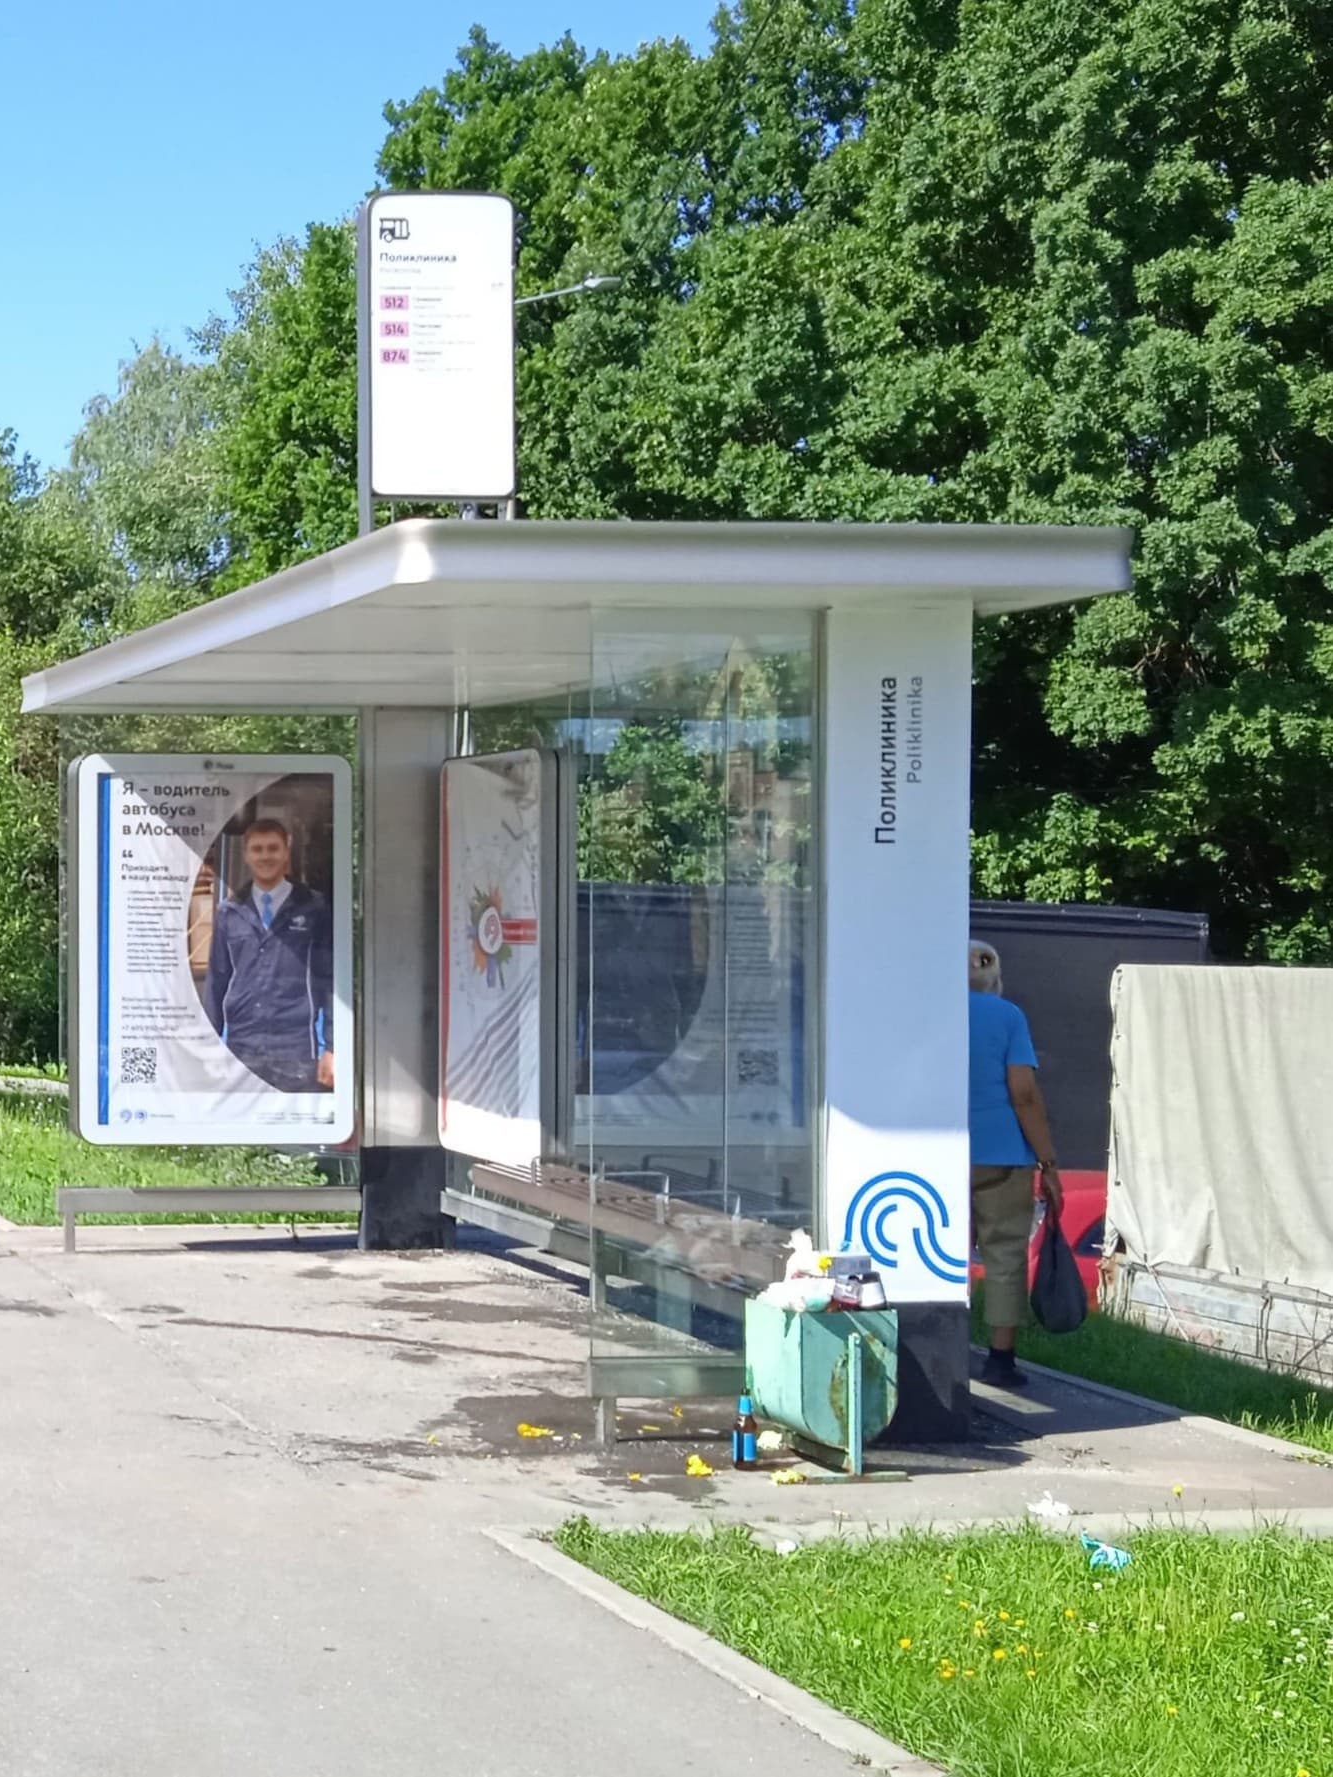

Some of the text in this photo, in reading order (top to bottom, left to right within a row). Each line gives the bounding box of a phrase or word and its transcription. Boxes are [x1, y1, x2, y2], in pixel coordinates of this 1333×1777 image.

[379, 252, 457, 262] Поликлиника
[384, 297, 404, 309] 512
[384, 323, 405, 336] 514
[382, 350, 406, 363] 874
[906, 675, 923, 784] Poliklinika
[874, 676, 897, 844] Поликлиника
[122, 781, 134, 795] Я
[153, 785, 231, 798] водитель
[122, 802, 196, 819] автобуса
[122, 821, 206, 837] в Москве!
[121, 863, 170, 873] Приходите
[152, 875, 190, 883] команду
